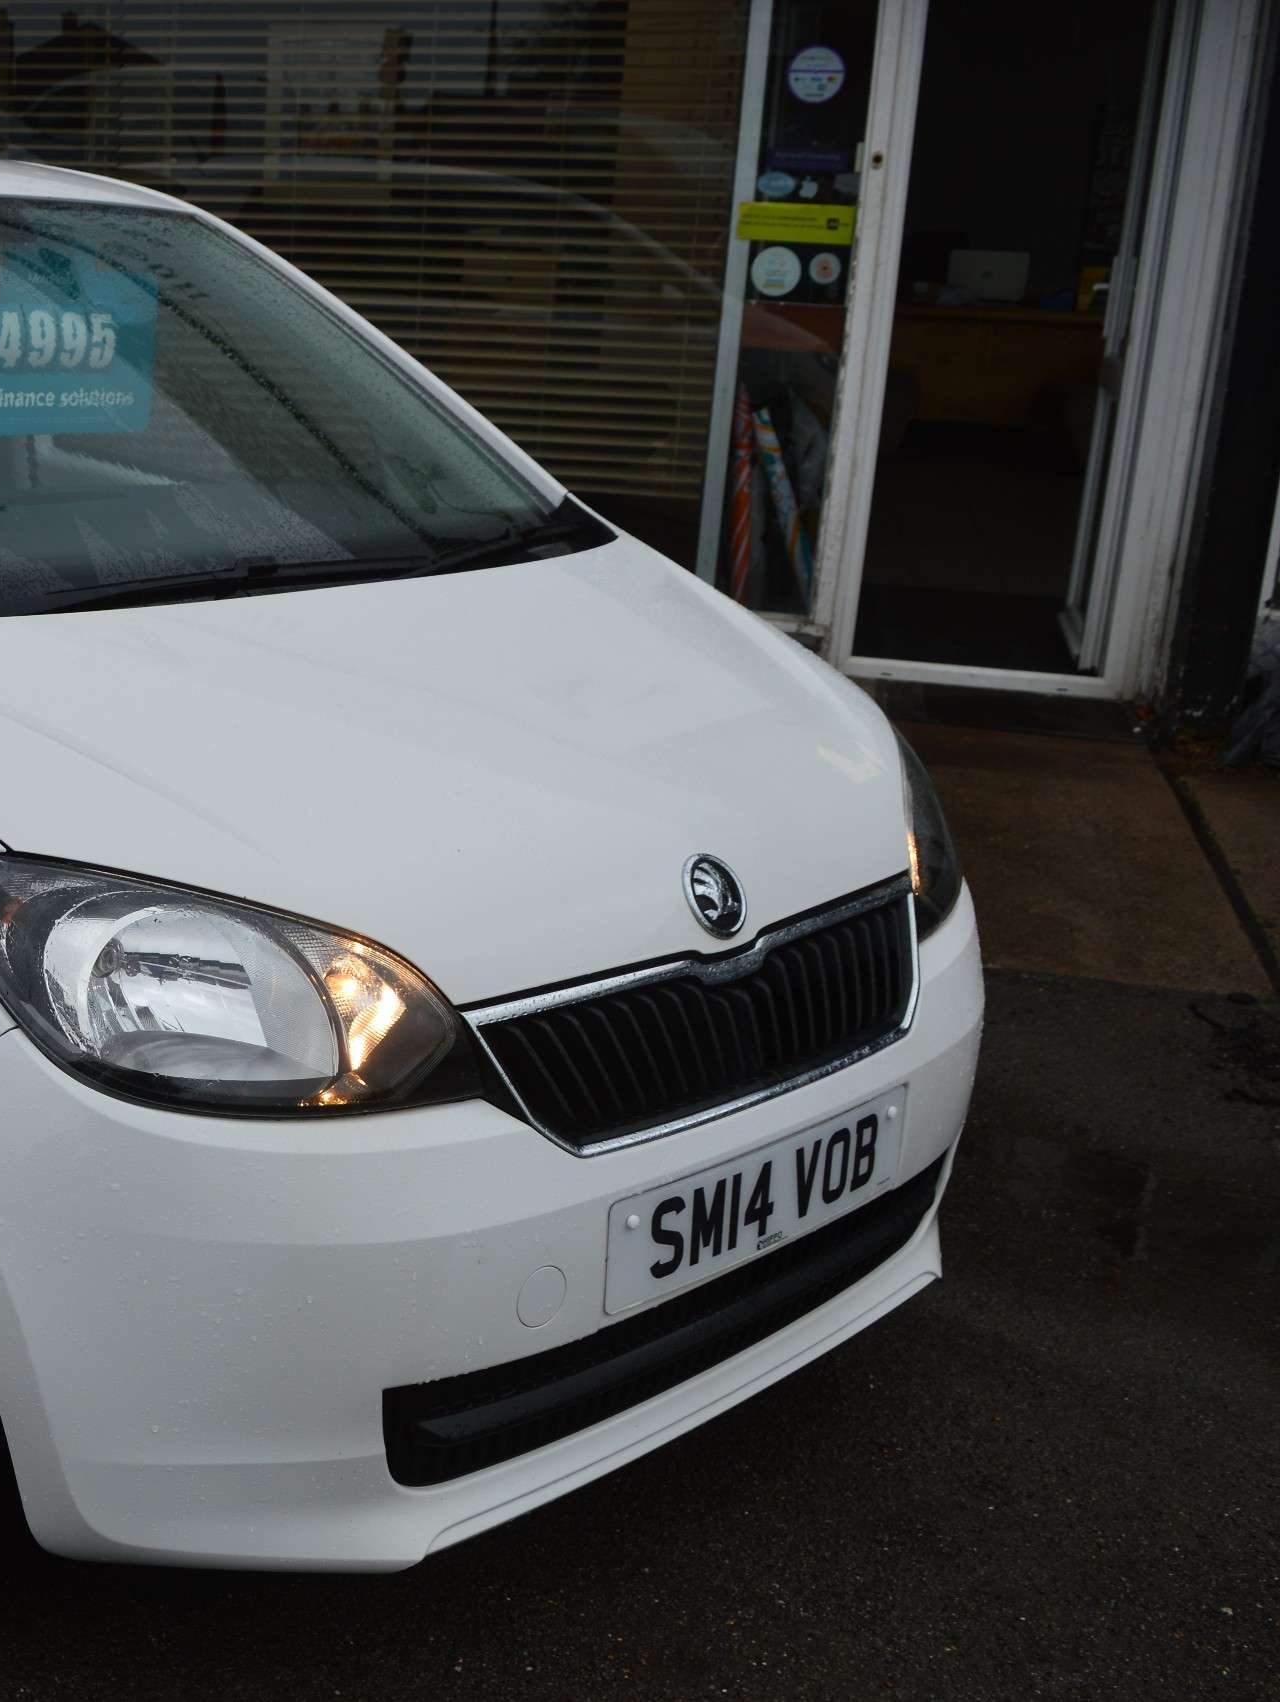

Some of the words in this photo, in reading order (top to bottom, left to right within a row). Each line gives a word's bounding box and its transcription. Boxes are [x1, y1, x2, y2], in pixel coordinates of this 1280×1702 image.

[59, 387, 136, 409] solutions
[649, 1159, 774, 1280] SM14
[794, 1112, 879, 1219] VOB
